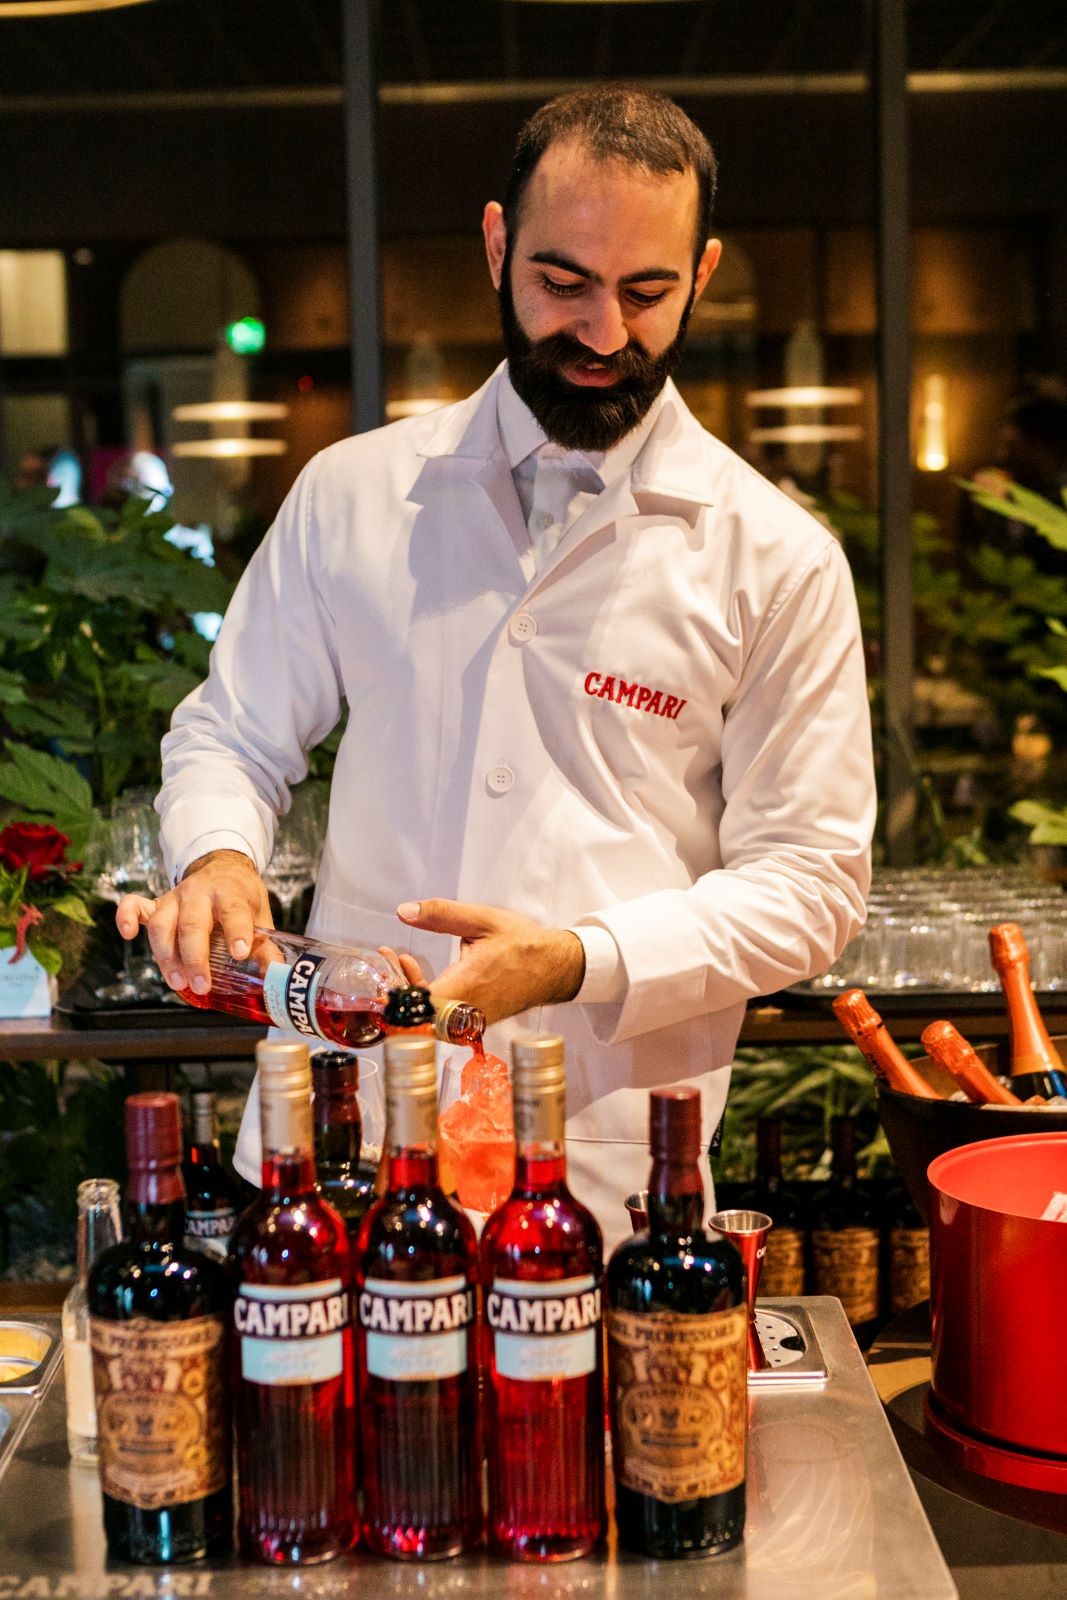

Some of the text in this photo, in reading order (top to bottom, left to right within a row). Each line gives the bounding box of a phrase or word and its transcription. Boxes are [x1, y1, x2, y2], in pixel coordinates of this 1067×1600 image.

[584, 672, 687, 720] CAMPARI
[289, 960, 322, 1040] CAMPA
[234, 1293, 348, 1337] CAMPARI
[360, 1290, 473, 1333] CAMPARI
[487, 1288, 601, 1333] CAMPARI
